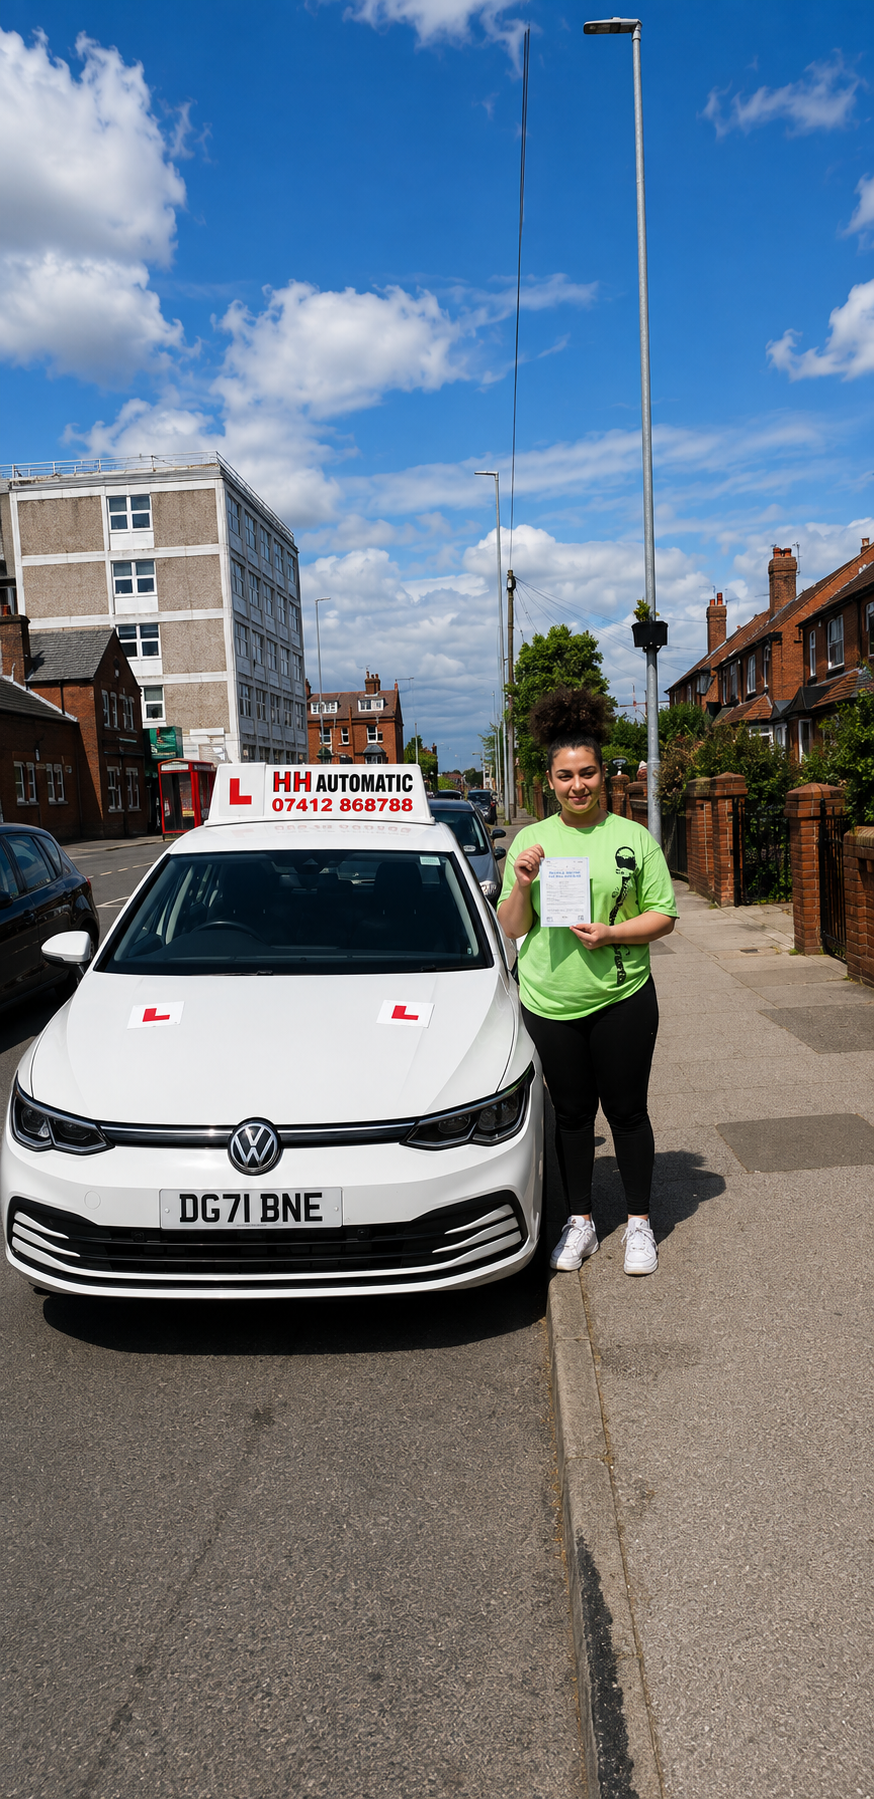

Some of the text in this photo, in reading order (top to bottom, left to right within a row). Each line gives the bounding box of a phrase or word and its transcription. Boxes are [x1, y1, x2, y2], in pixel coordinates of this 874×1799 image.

[273, 771, 413, 792] HH AUTOMATIC
[229, 778, 252, 805] L
[272, 798, 413, 812] 07412 868788
[142, 1008, 171, 1022] L
[391, 1005, 419, 1020] L
[179, 1193, 323, 1223] DG71 BNE
